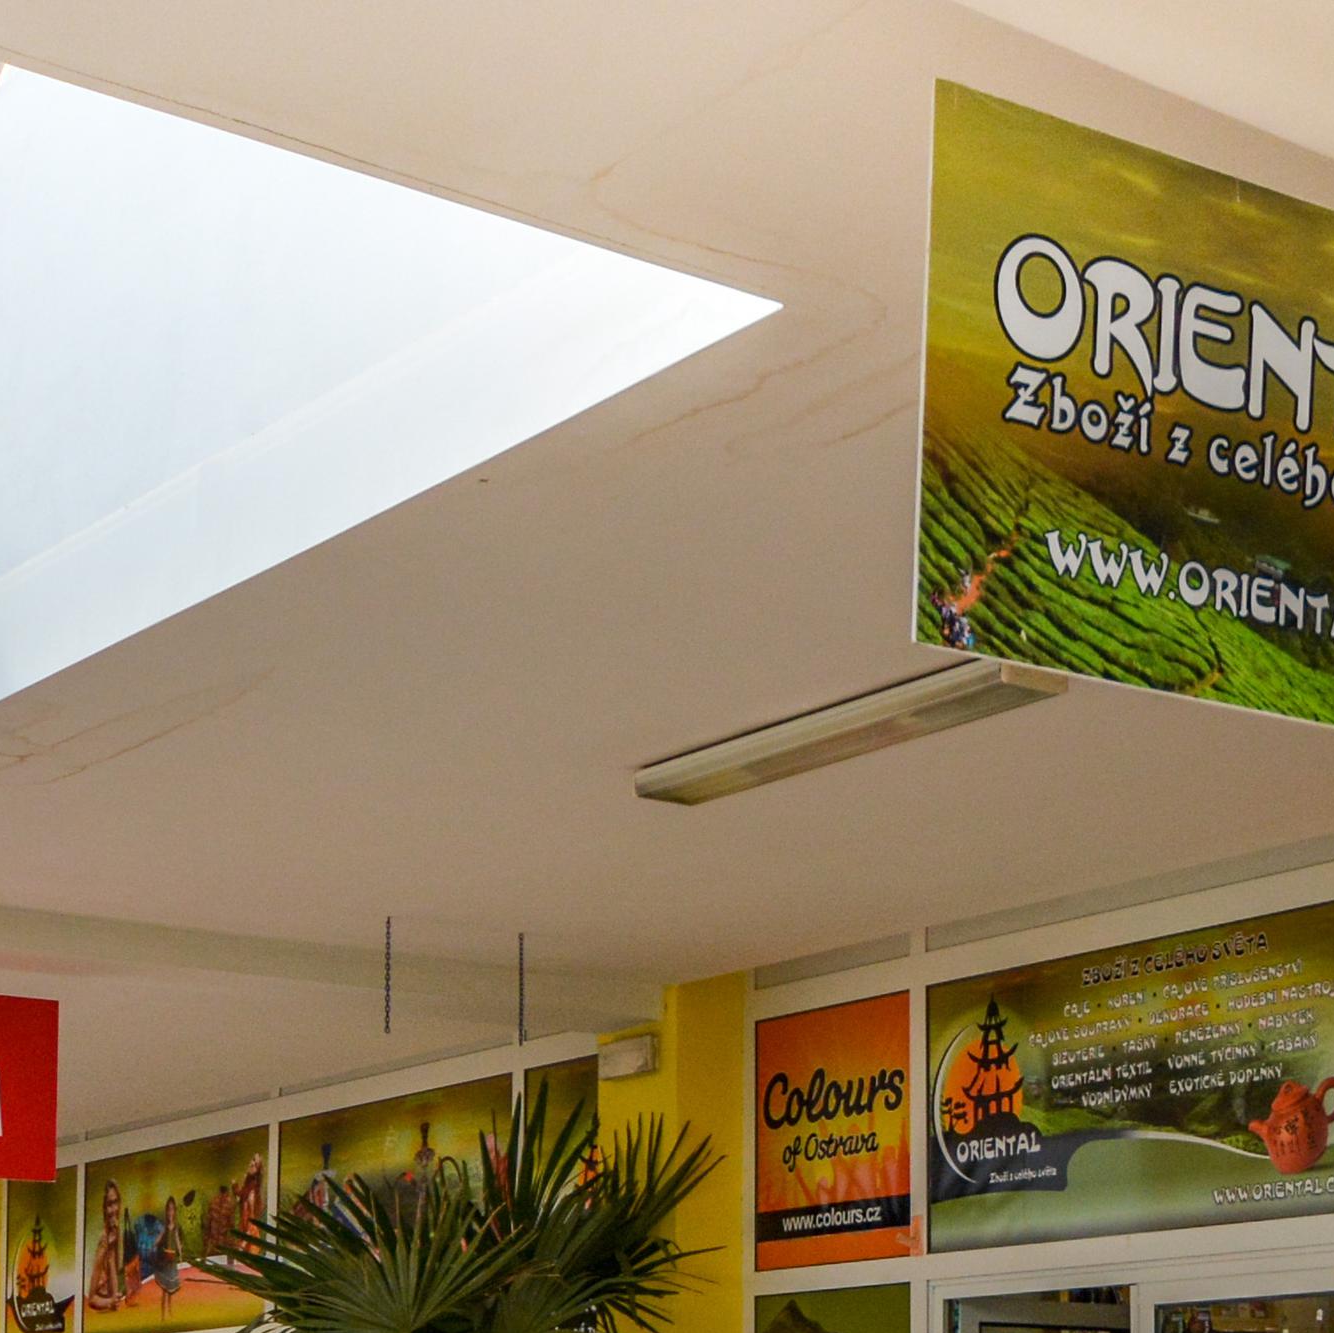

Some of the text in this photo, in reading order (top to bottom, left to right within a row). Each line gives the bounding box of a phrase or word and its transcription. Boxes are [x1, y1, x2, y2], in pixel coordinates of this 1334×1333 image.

[1003, 363, 1153, 453] Zboží
[1167, 425, 1191, 465] z
[762, 1067, 906, 1131] Colours
[781, 1130, 879, 1173] of Ostrava
[956, 1131, 1041, 1164] ORIENTAL
[781, 1204, 882, 1233] www.colours.cz
